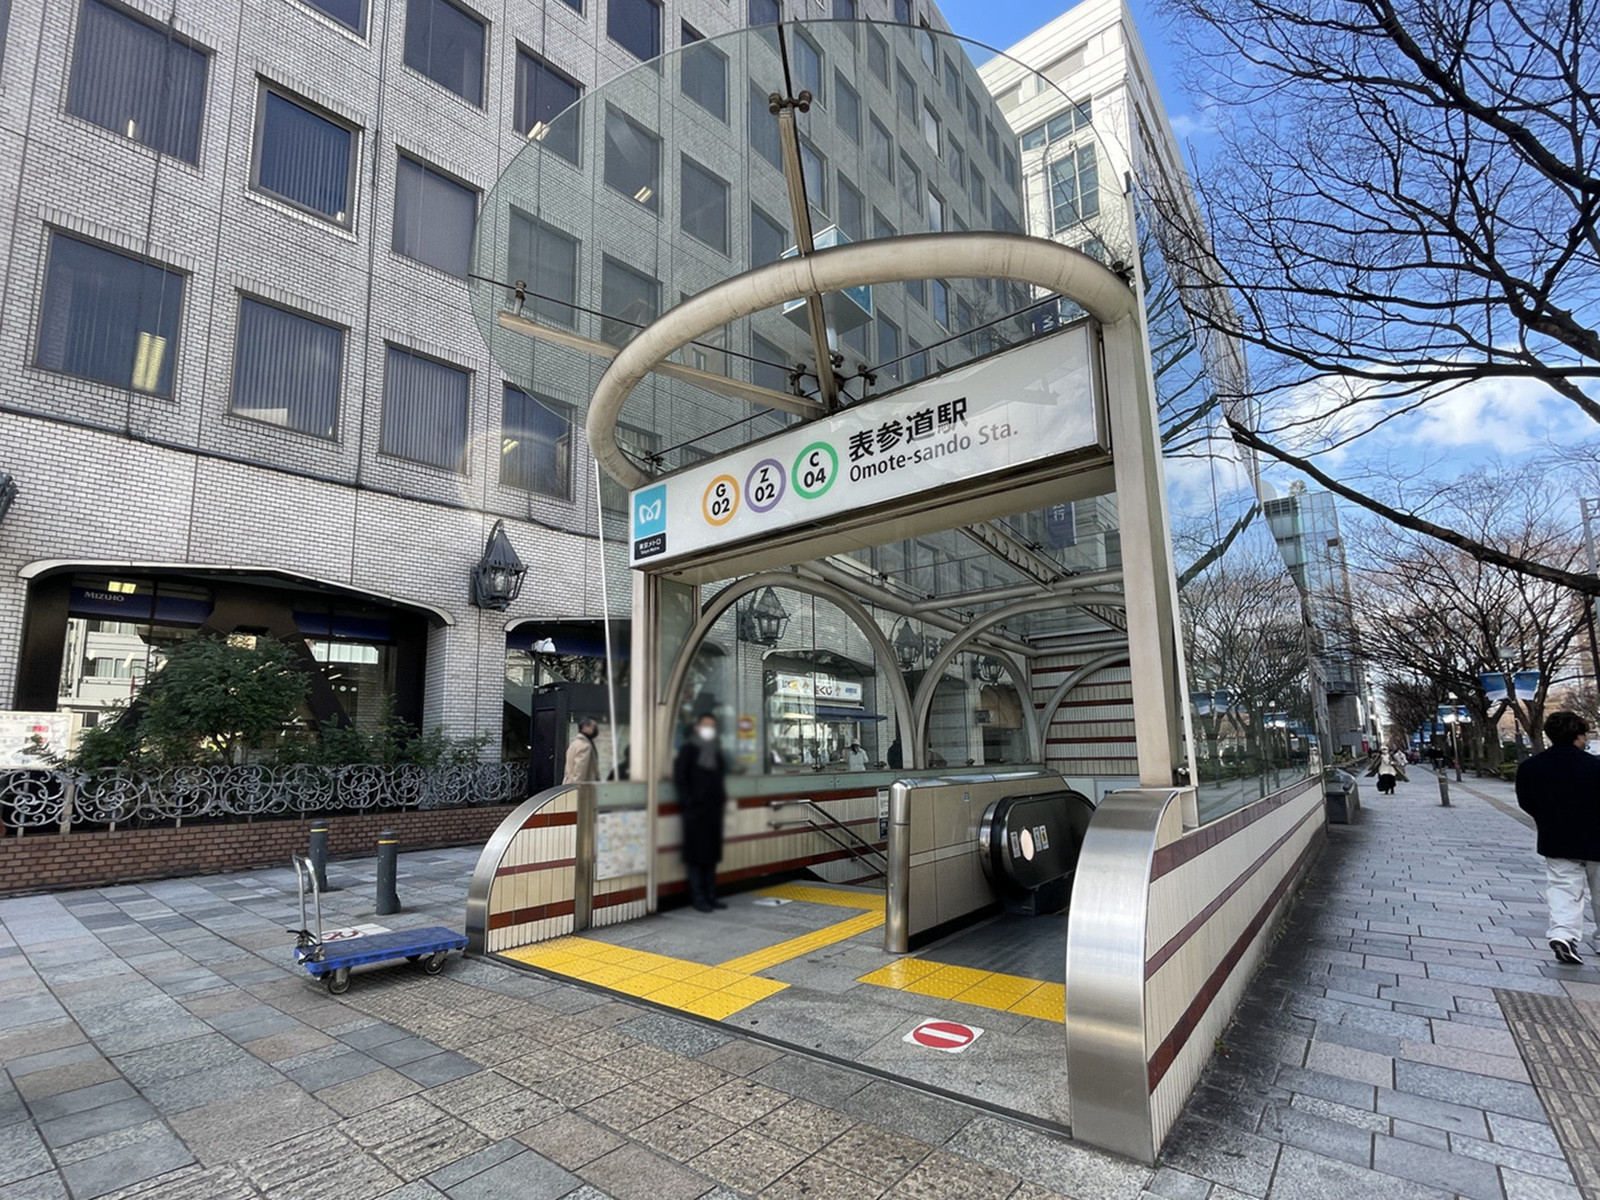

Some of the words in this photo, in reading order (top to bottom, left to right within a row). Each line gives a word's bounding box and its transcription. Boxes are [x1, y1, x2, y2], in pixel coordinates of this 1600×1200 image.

[849, 397, 969, 463] 表参道駅
[809, 451, 820, 468] C
[849, 433, 972, 483] Omote-sando
[978, 422, 1019, 446] Sta.
[759, 467, 770, 484] Z
[804, 467, 826, 488] 04
[715, 483, 727, 498] G
[755, 483, 775, 502] 02
[712, 498, 730, 516] 02
